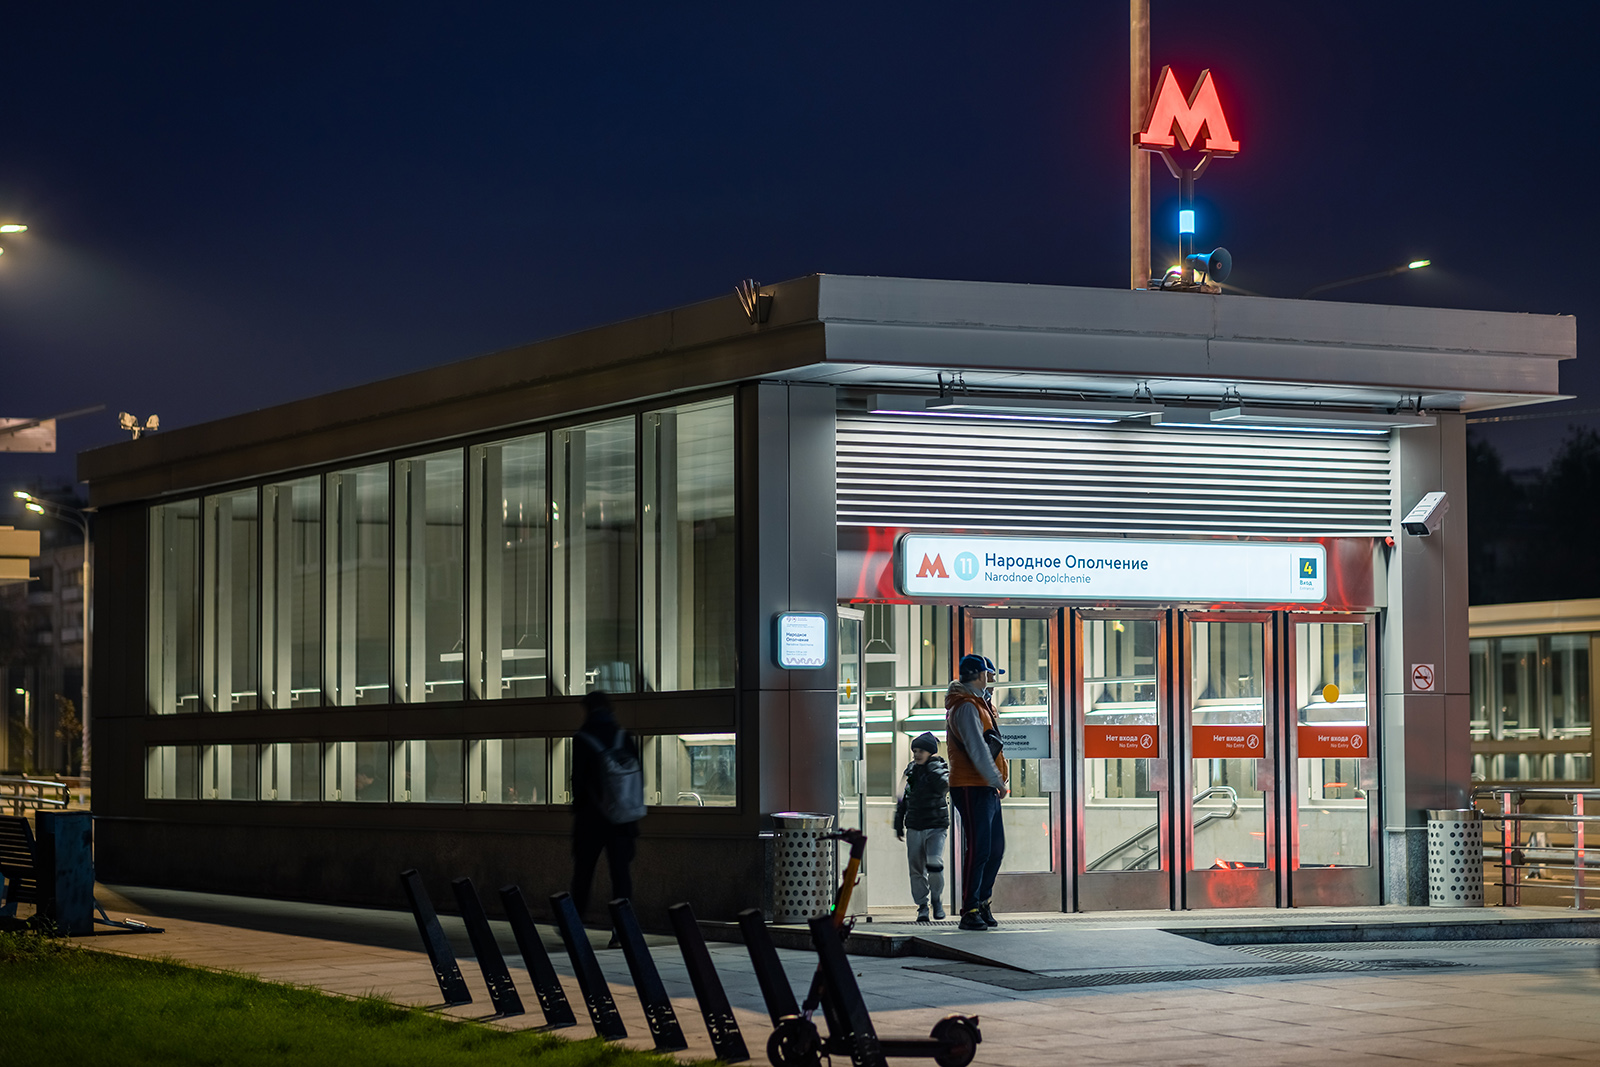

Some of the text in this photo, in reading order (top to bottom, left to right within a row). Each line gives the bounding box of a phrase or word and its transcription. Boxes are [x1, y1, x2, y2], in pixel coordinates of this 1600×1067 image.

[1136, 65, 1240, 152] М
[916, 552, 1149, 578] М 11 Народное Ополчение
[1303, 562, 1313, 574] 4
[984, 572, 1092, 584] Narodnoe Opolchenie
